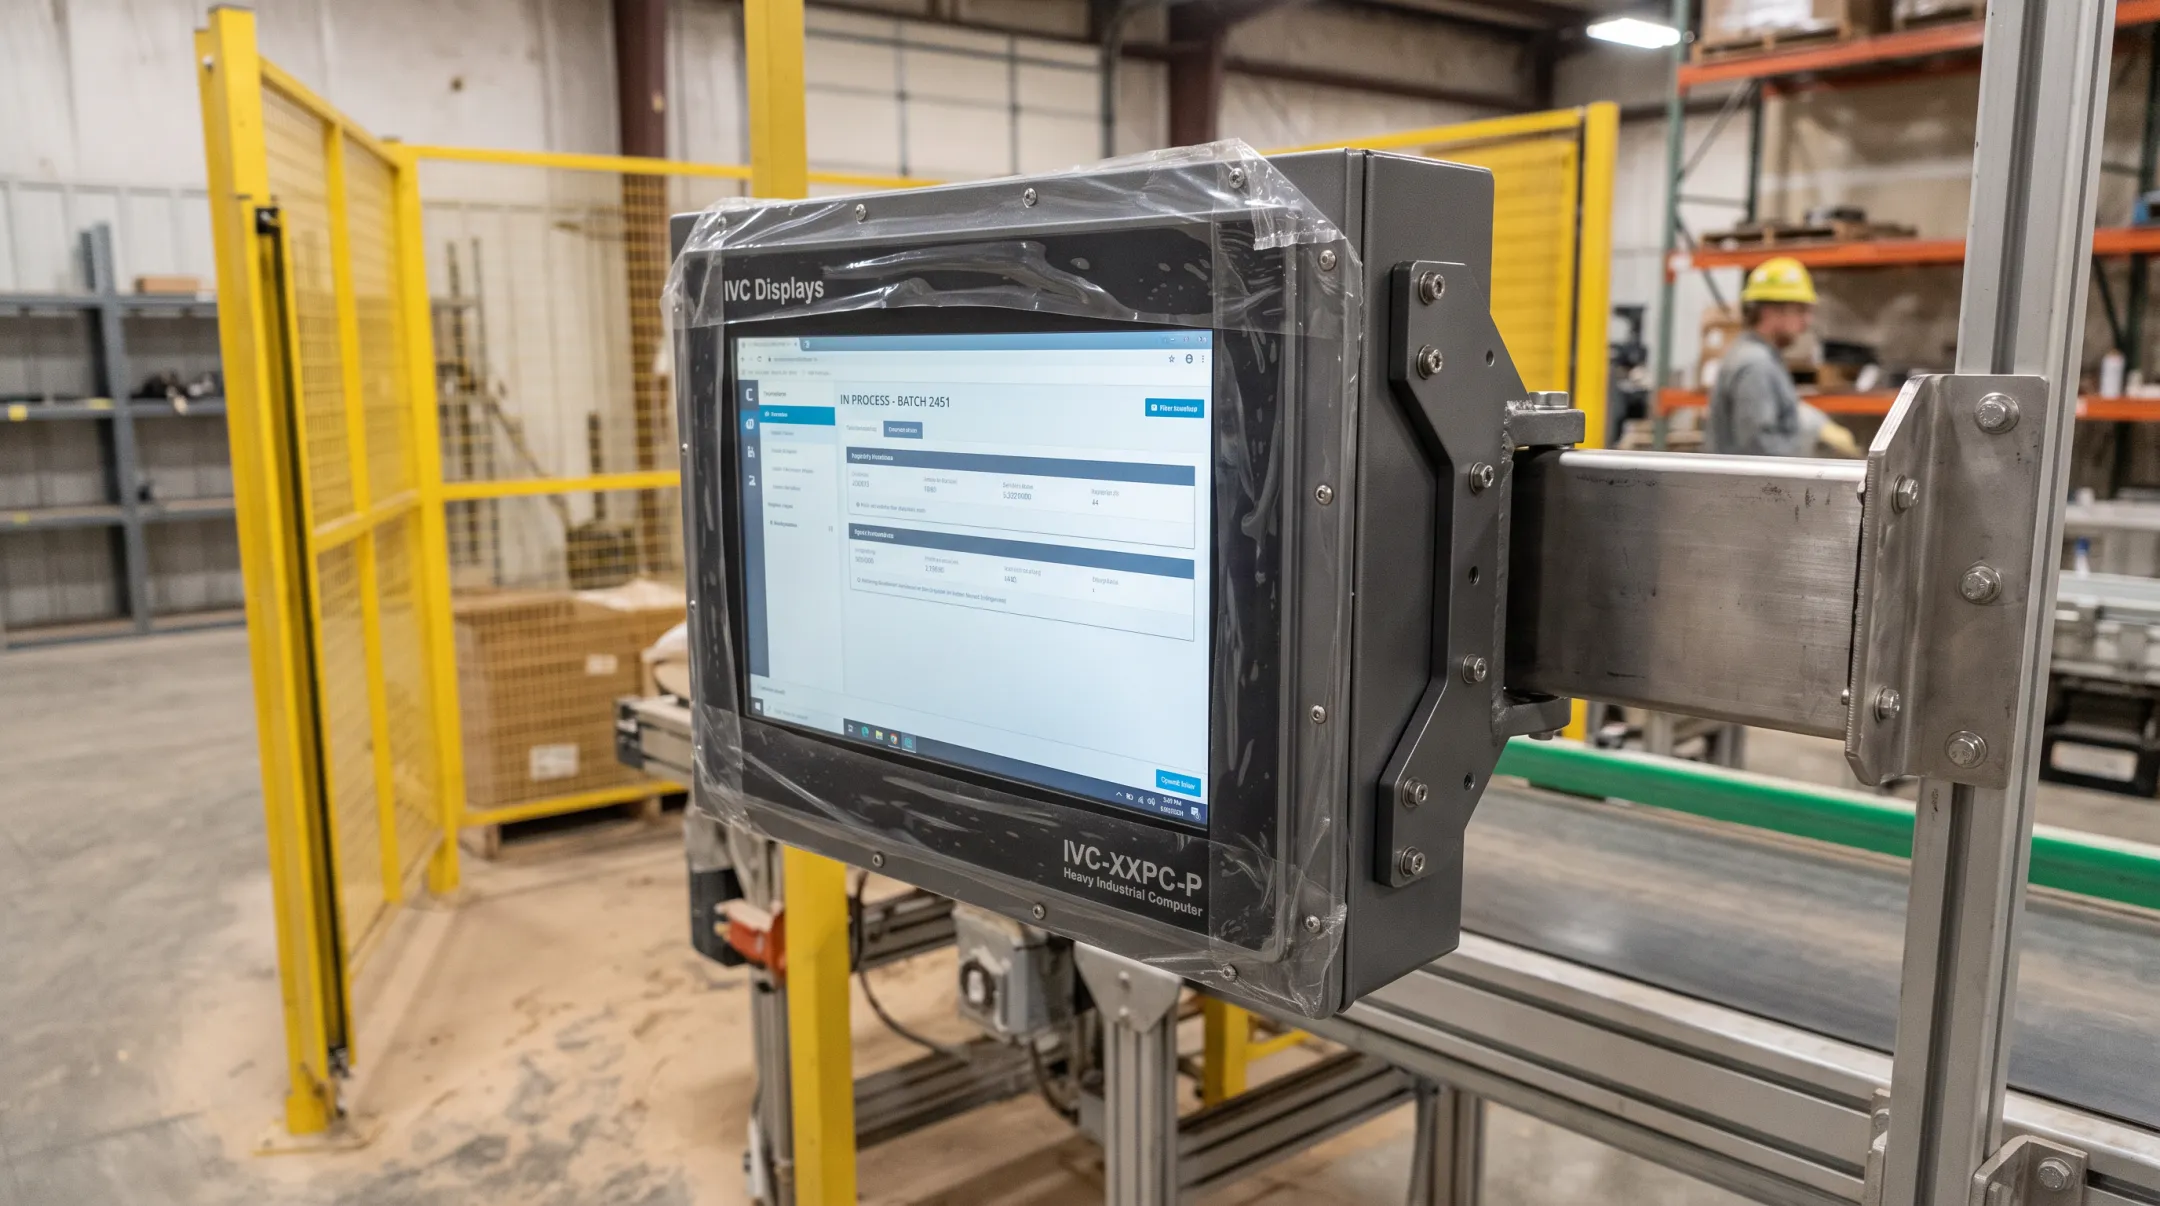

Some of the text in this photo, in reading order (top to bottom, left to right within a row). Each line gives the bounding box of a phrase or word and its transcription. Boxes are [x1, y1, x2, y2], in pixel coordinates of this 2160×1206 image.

[724, 276, 824, 305] IVC Displays
[840, 394, 850, 405] IN
[851, 394, 890, 406] PROCESS
[897, 395, 927, 407] BATCH
[929, 396, 950, 408] 2451
[1063, 839, 1203, 897] IVC-XXPC-P
[1063, 866, 1204, 917] Heavy Industrial Computer
